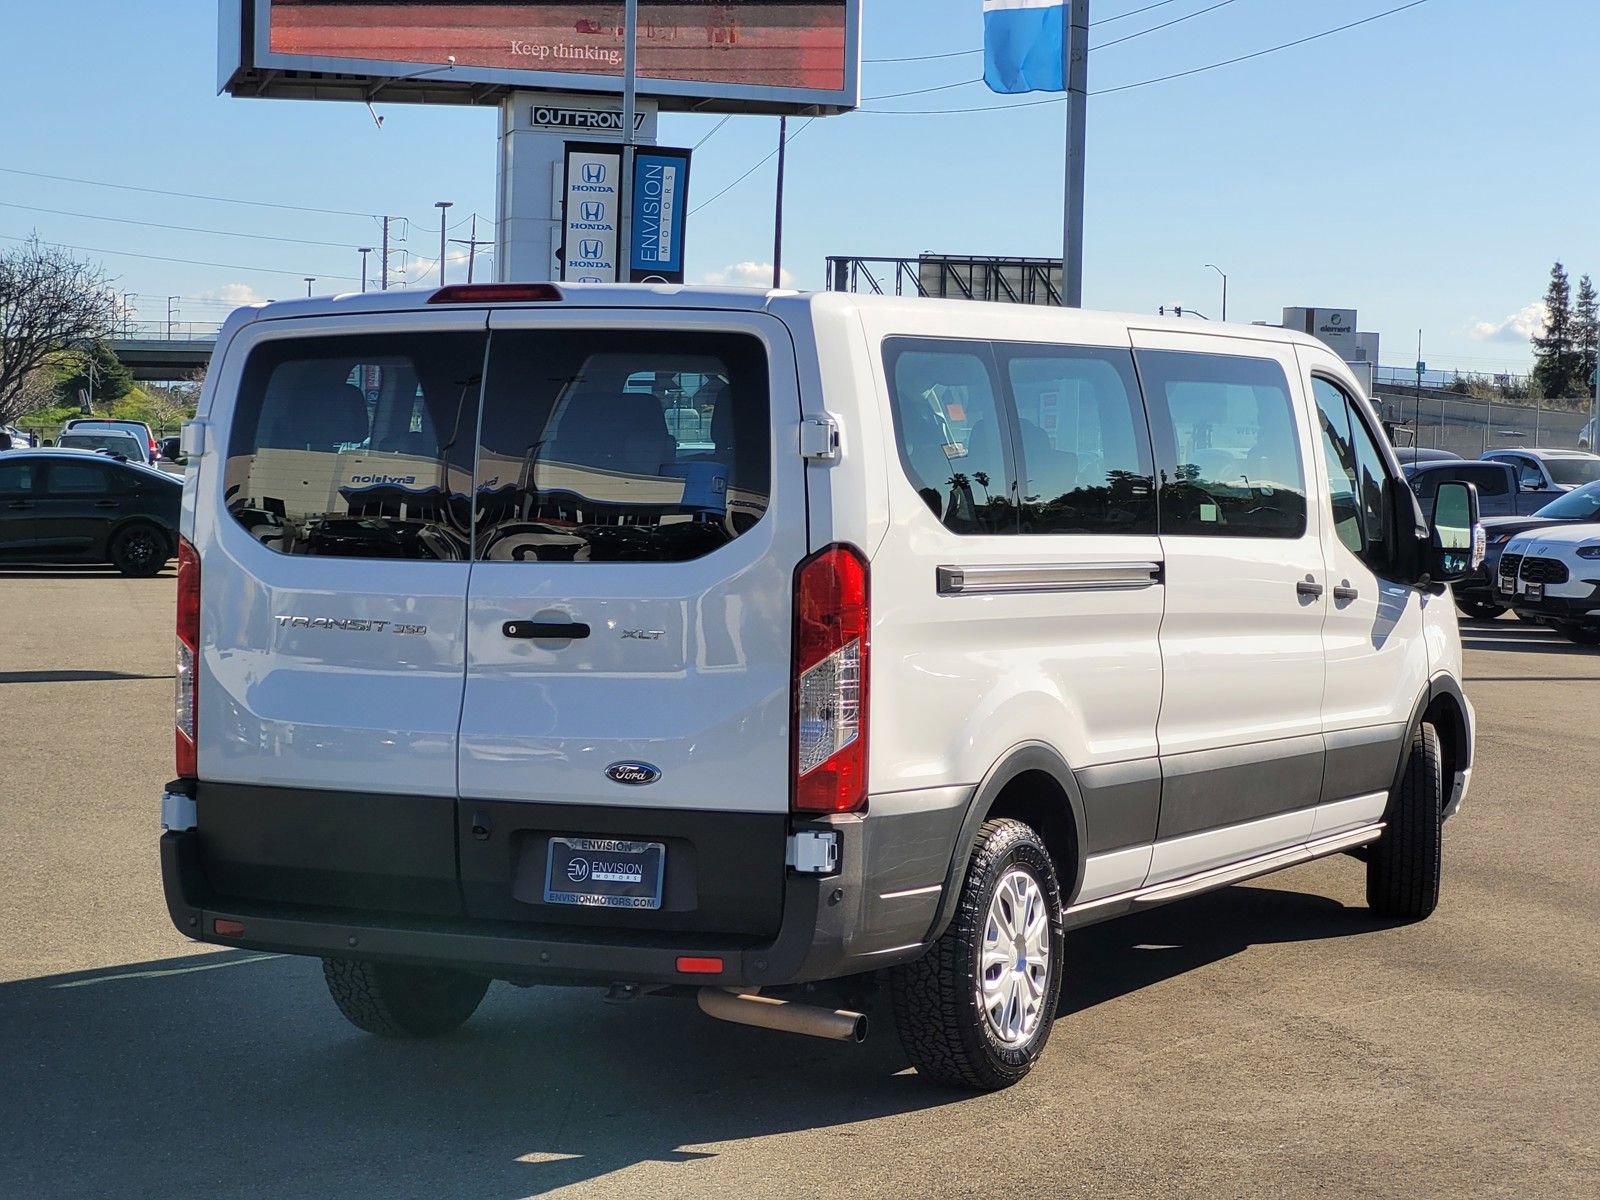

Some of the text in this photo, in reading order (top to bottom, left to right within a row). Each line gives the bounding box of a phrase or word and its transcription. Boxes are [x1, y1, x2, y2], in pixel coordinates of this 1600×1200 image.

[511, 40, 623, 64] Keep thinking.
[536, 110, 640, 128] OUTFRON
[571, 185, 614, 193] HONDA
[641, 164, 662, 261] ENVISION
[661, 175, 672, 254] MOTORS
[570, 223, 613, 231] HONDA
[569, 261, 612, 269] HONDA
[1320, 325, 1351, 333] element
[274, 615, 427, 635] TRANSIT 350
[621, 629, 665, 640] XLT
[616, 765, 647, 781] Ford
[581, 840, 632, 852] ENVISION
[592, 862, 643, 874] ENVISION
[550, 893, 656, 908] ENVISIONMOTORS.COM
